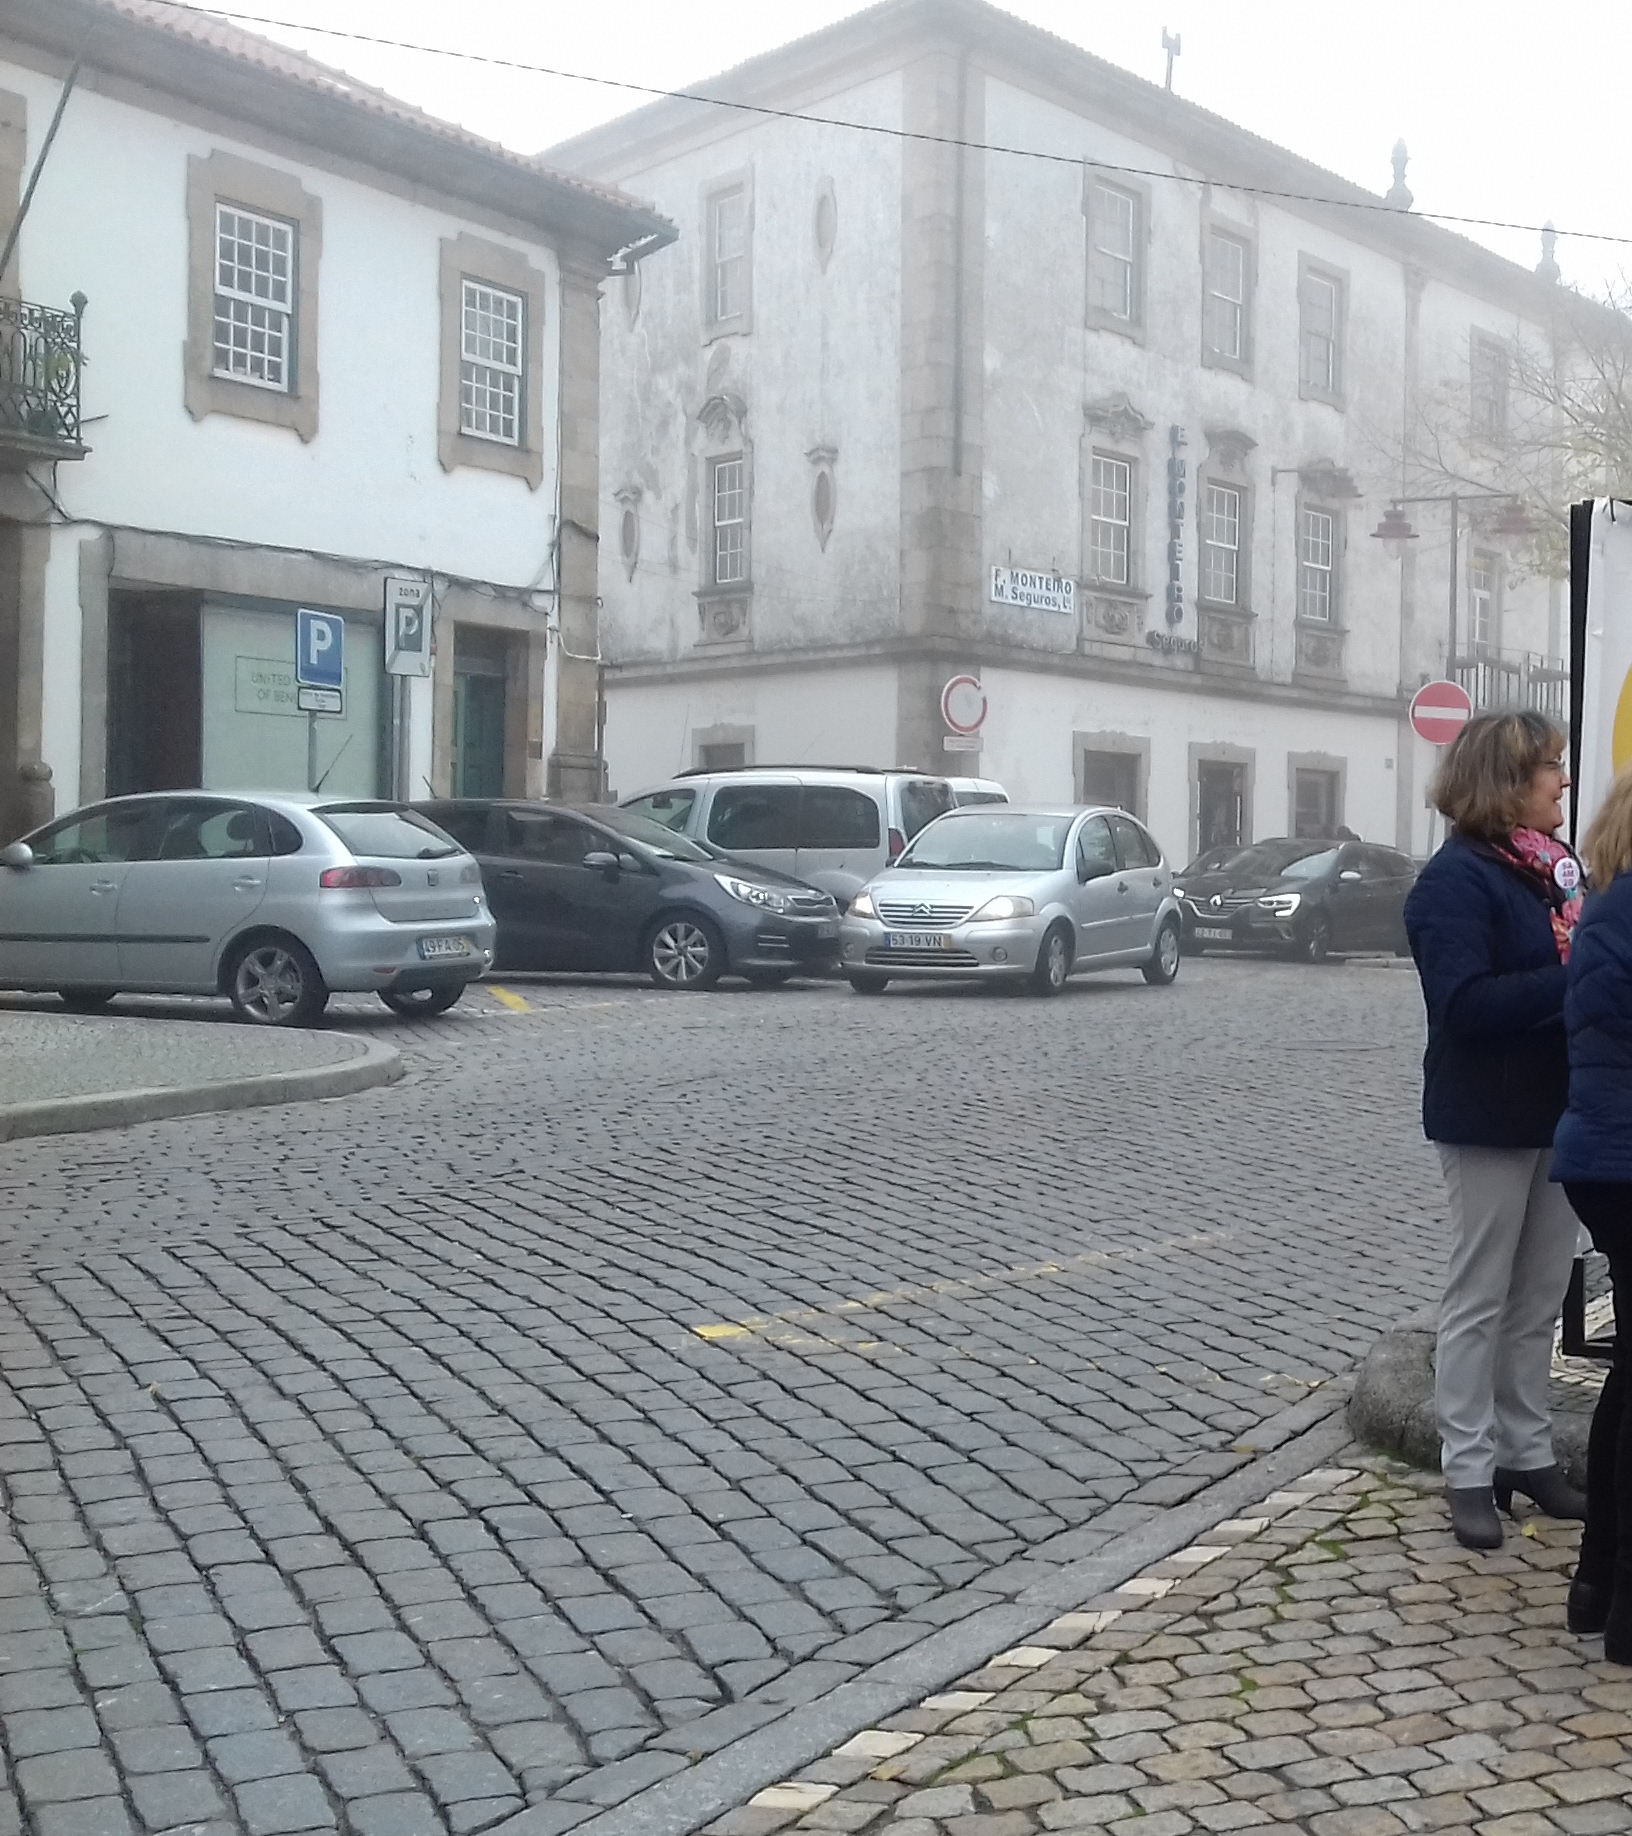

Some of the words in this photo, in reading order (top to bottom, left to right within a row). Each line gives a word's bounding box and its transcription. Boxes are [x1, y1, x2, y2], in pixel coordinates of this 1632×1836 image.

[399, 587, 420, 598] zona
[1010, 570, 1072, 595] MONTEIRO
[1011, 586, 1061, 611] Seguros,
[399, 607, 419, 648] P
[309, 619, 333, 665] P
[251, 673, 291, 687] UNITED
[257, 689, 271, 700] OF
[273, 690, 297, 703] BEN
